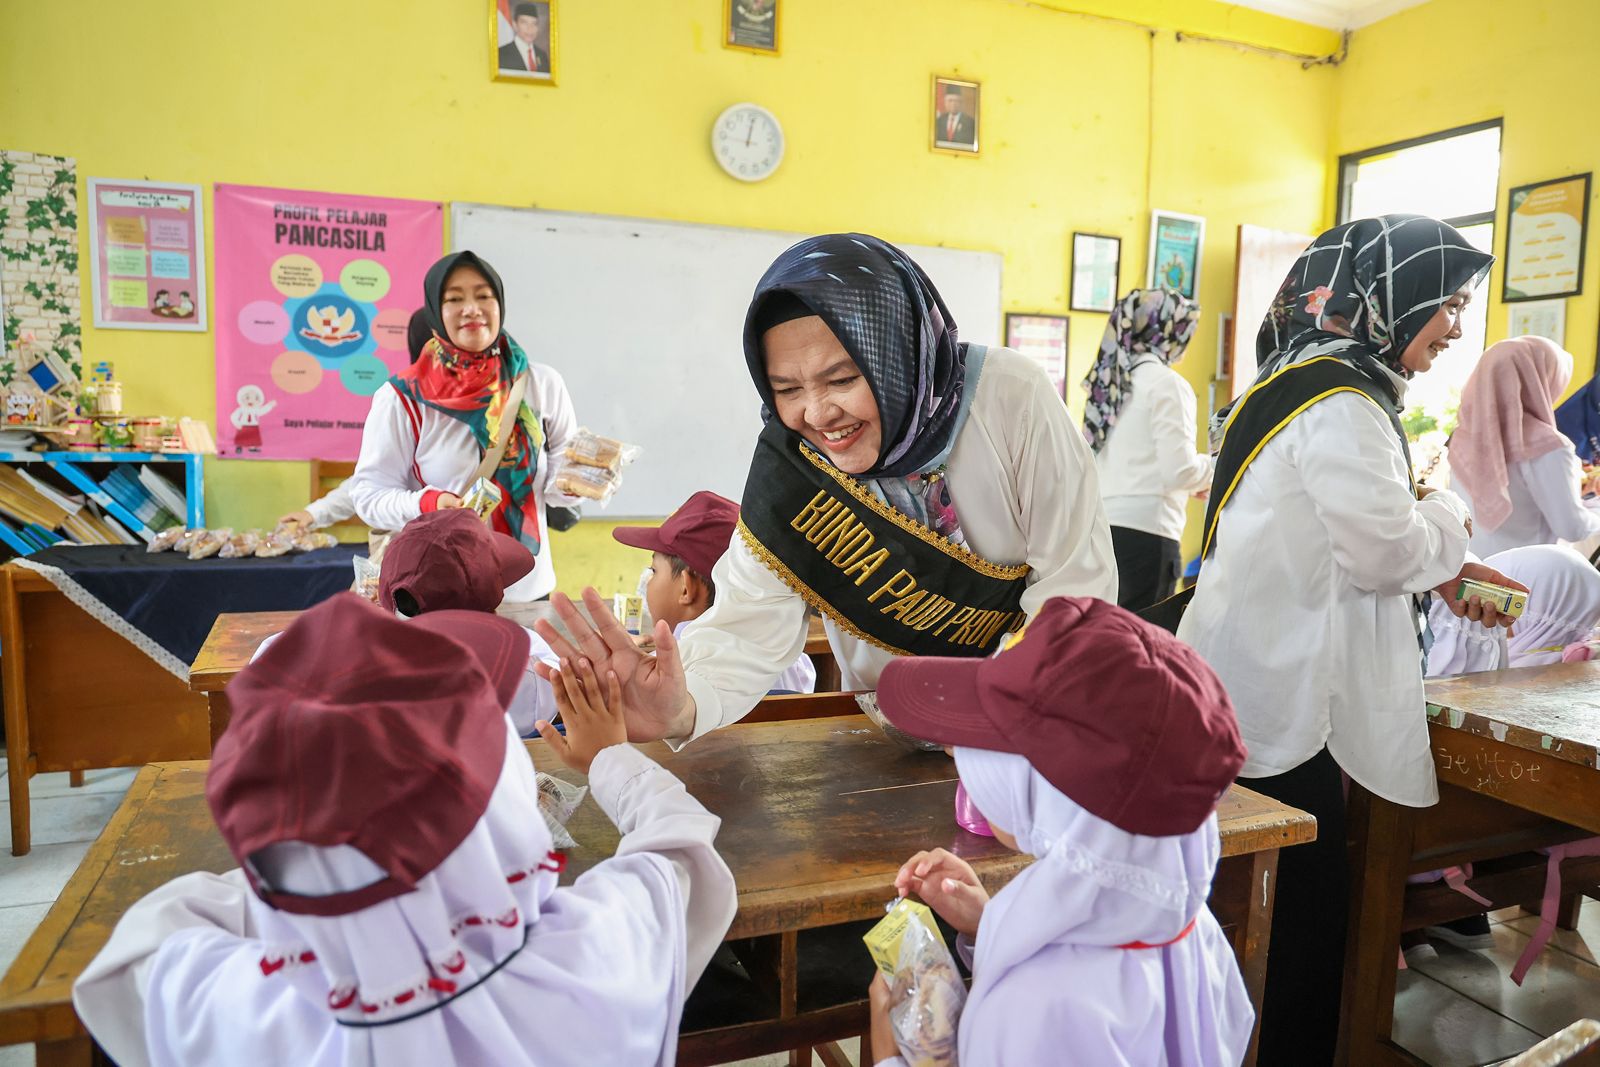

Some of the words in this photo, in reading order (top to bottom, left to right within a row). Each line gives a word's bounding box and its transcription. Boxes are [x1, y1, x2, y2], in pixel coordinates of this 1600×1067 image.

[273, 204, 321, 222] PROFIL
[327, 208, 387, 228] PELAJAR
[275, 222, 386, 252] PANCASILA
[790, 489, 890, 587] BUNDA
[867, 568, 956, 637] PAUD
